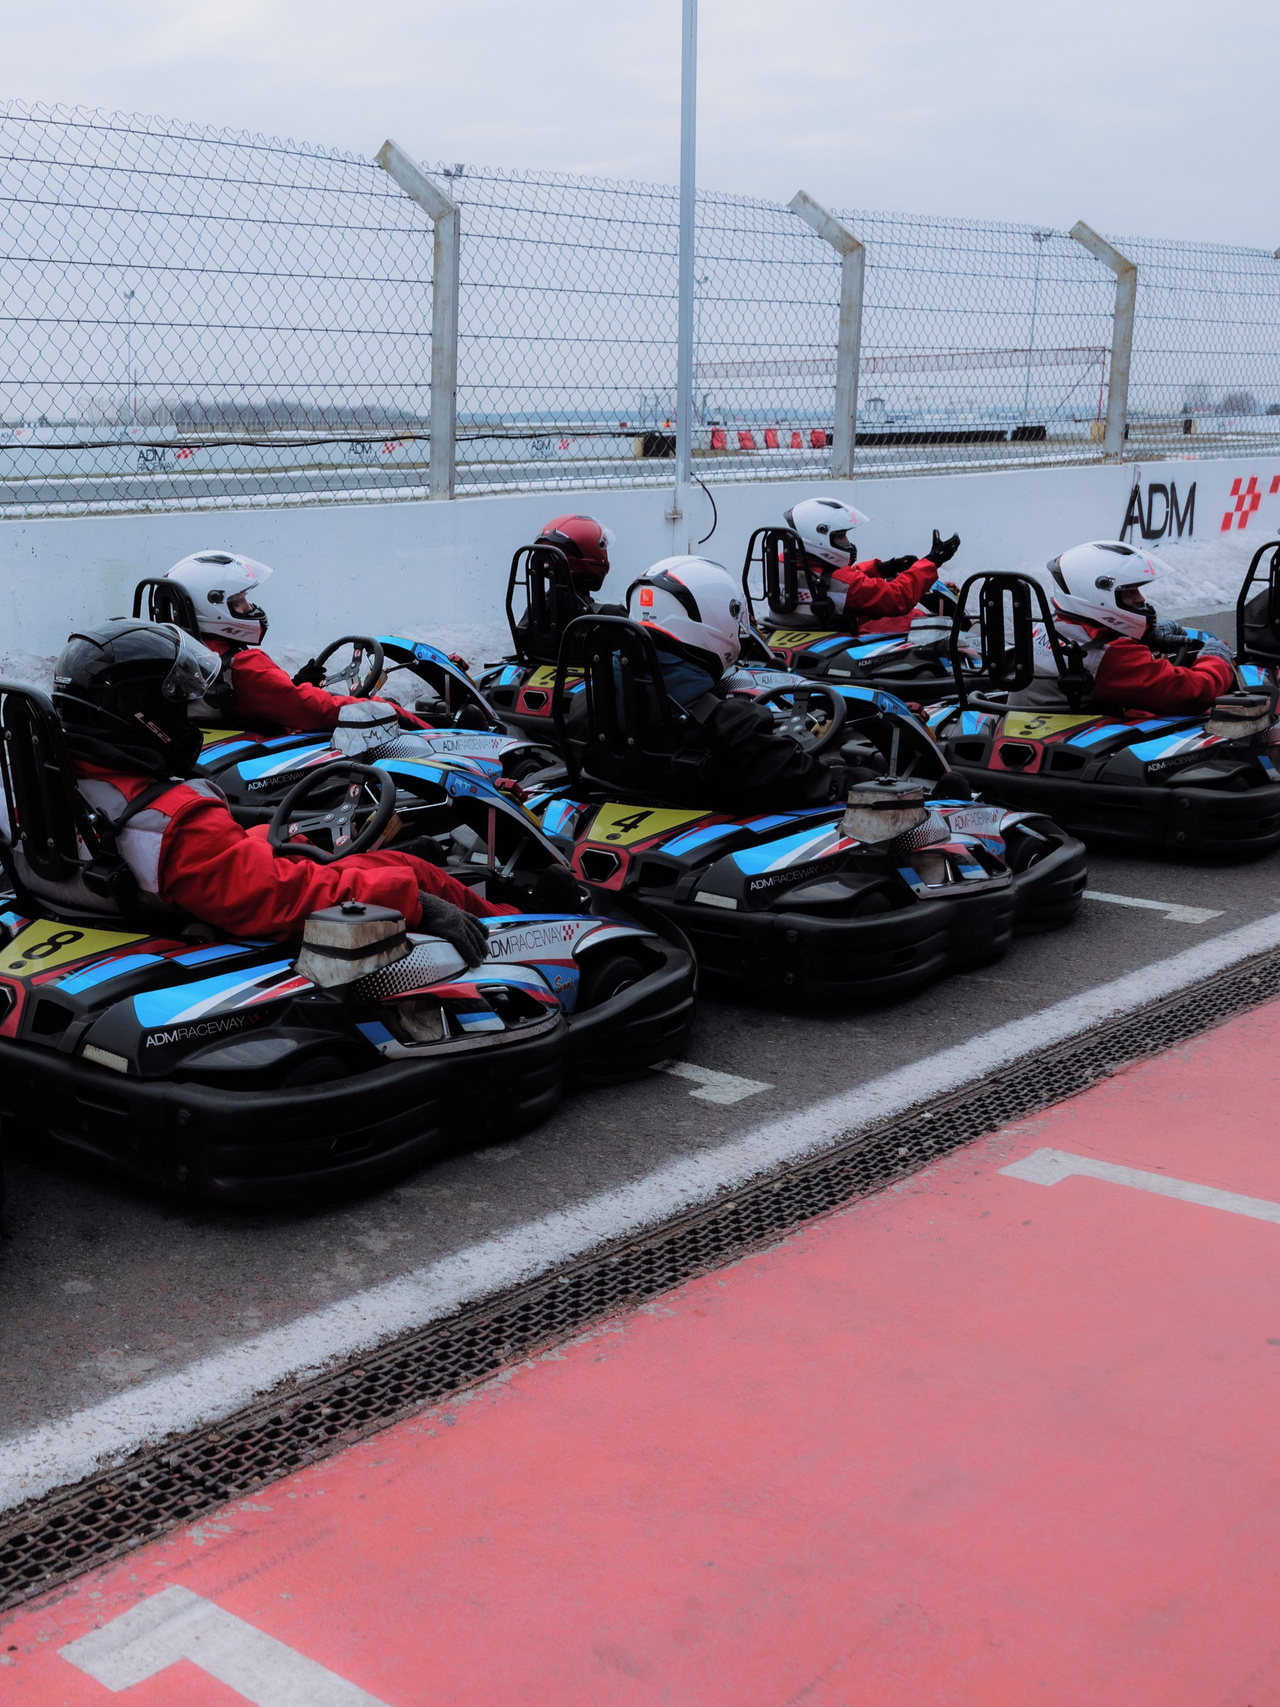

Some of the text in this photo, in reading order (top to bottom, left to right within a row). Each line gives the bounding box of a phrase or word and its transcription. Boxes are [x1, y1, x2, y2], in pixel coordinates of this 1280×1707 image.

[137, 449, 166, 461] ADM
[1120, 482, 1196, 542] ADM
[776, 631, 811, 644] 10
[134, 712, 172, 744] LS2
[1024, 716, 1053, 731] 5
[1147, 754, 1199, 773] ADMRACEWAY
[248, 771, 305, 791] ADMRACEWAY
[610, 810, 656, 834] 4
[750, 865, 819, 891] ADMRACEWAY
[39, 929, 84, 960] 8
[146, 1016, 246, 1048] ADMRACEWAY
